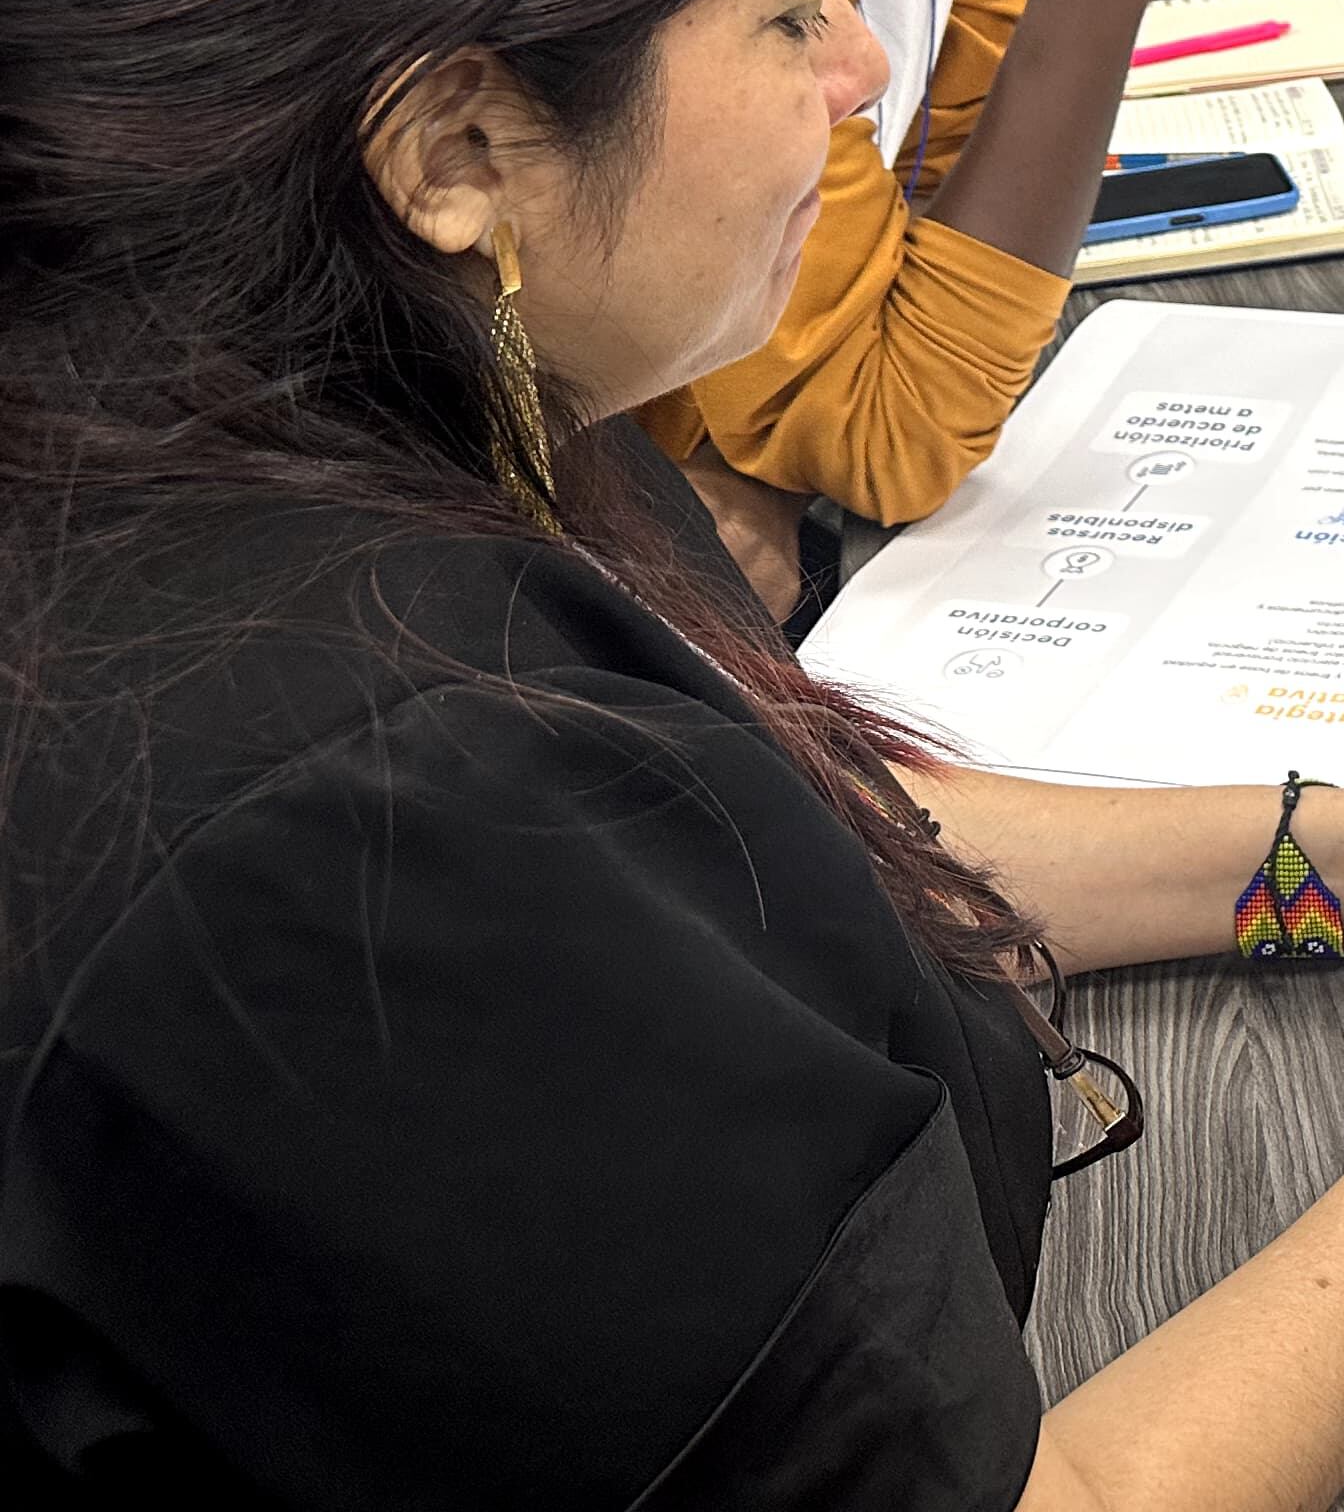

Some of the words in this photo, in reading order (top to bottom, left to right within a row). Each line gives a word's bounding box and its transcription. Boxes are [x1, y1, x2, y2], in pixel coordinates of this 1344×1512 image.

[1157, 402, 1230, 417] metas
[1238, 408, 1252, 416] a
[1127, 416, 1225, 432] acuerdo
[1233, 424, 1262, 436] de
[1114, 431, 1254, 452] Priorización
[1048, 513, 1192, 532] disponibles
[1047, 527, 1162, 544] Recursos
[949, 609, 1106, 633] corporativa
[957, 626, 1072, 647] Decisión
